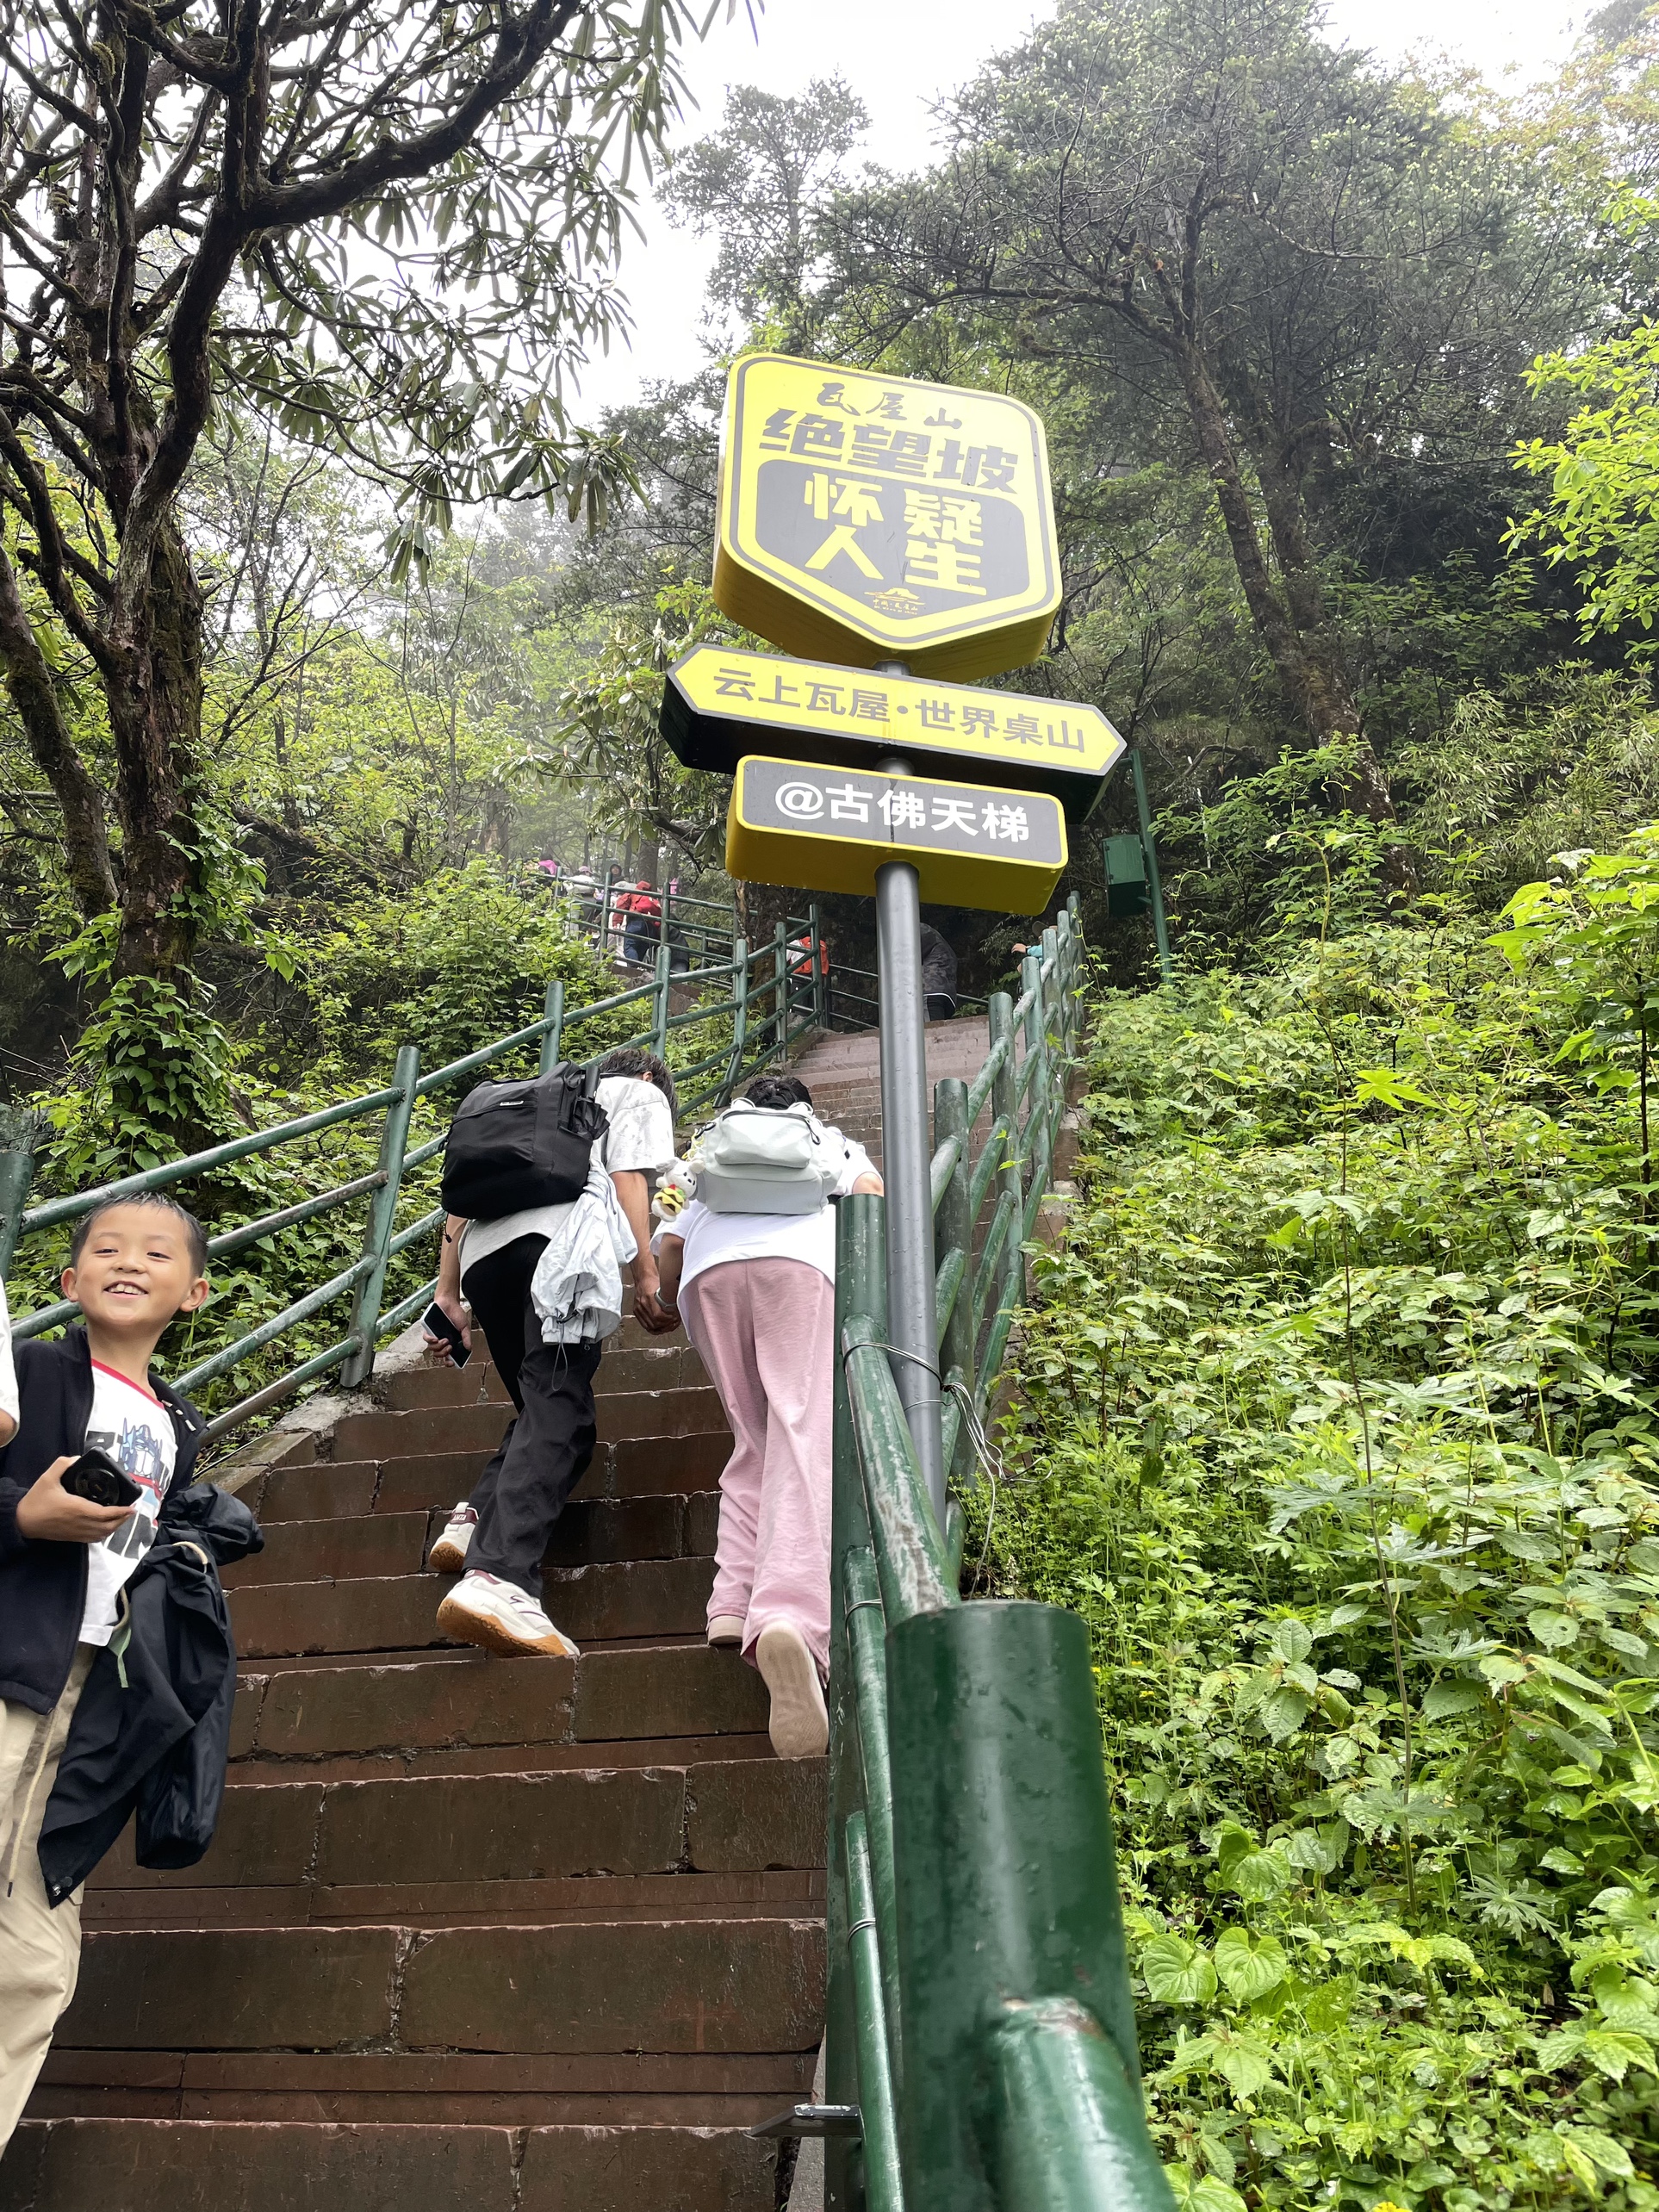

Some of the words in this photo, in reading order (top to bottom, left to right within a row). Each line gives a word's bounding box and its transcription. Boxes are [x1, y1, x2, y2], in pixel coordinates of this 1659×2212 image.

[817, 382, 962, 429] 瓦屋山
[759, 407, 1019, 494] 绝望坡
[804, 472, 984, 547] 怀疑
[805, 525, 987, 596] 人生
[713, 667, 1084, 753] 云上瓦屋·世界桌山
[774, 780, 1029, 842] @古佛天梯
